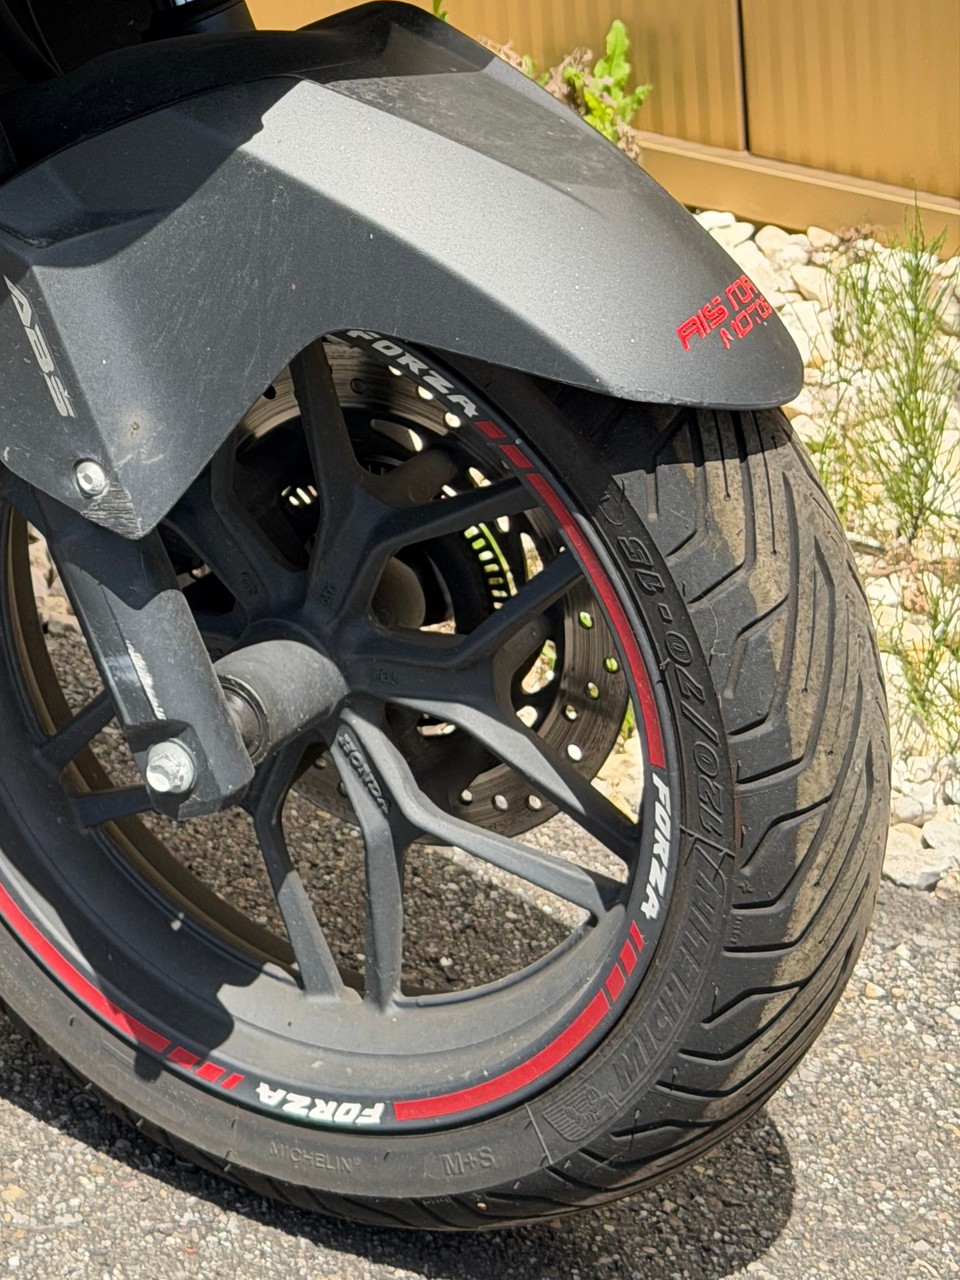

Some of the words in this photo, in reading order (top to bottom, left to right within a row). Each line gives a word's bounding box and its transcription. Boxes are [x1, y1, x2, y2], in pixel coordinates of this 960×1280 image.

[3, 274, 77, 418] ABS
[345, 329, 479, 418] FORZA
[337, 733, 388, 815] HONDA
[640, 772, 672, 919] FORZA
[255, 1081, 385, 1125] FORZA
[441, 1146, 496, 1176] M+S
